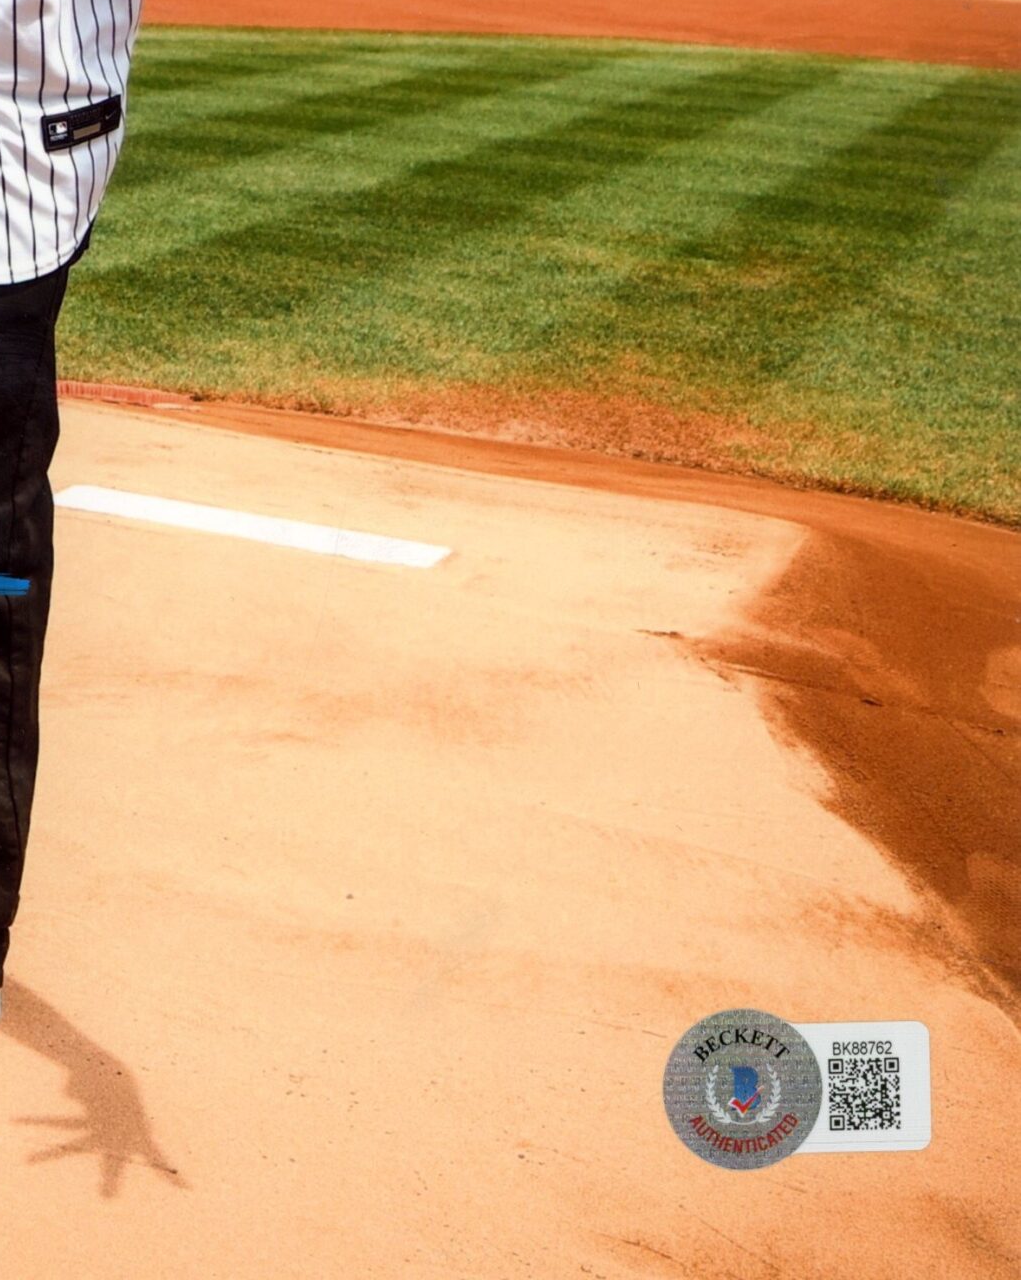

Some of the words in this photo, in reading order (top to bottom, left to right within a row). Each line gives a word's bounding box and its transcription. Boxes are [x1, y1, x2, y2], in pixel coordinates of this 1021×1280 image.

[692, 1027, 791, 1064] BECKETT
[832, 1040, 893, 1056] BK88762
[689, 1112, 800, 1154] AUTHENTICATED
